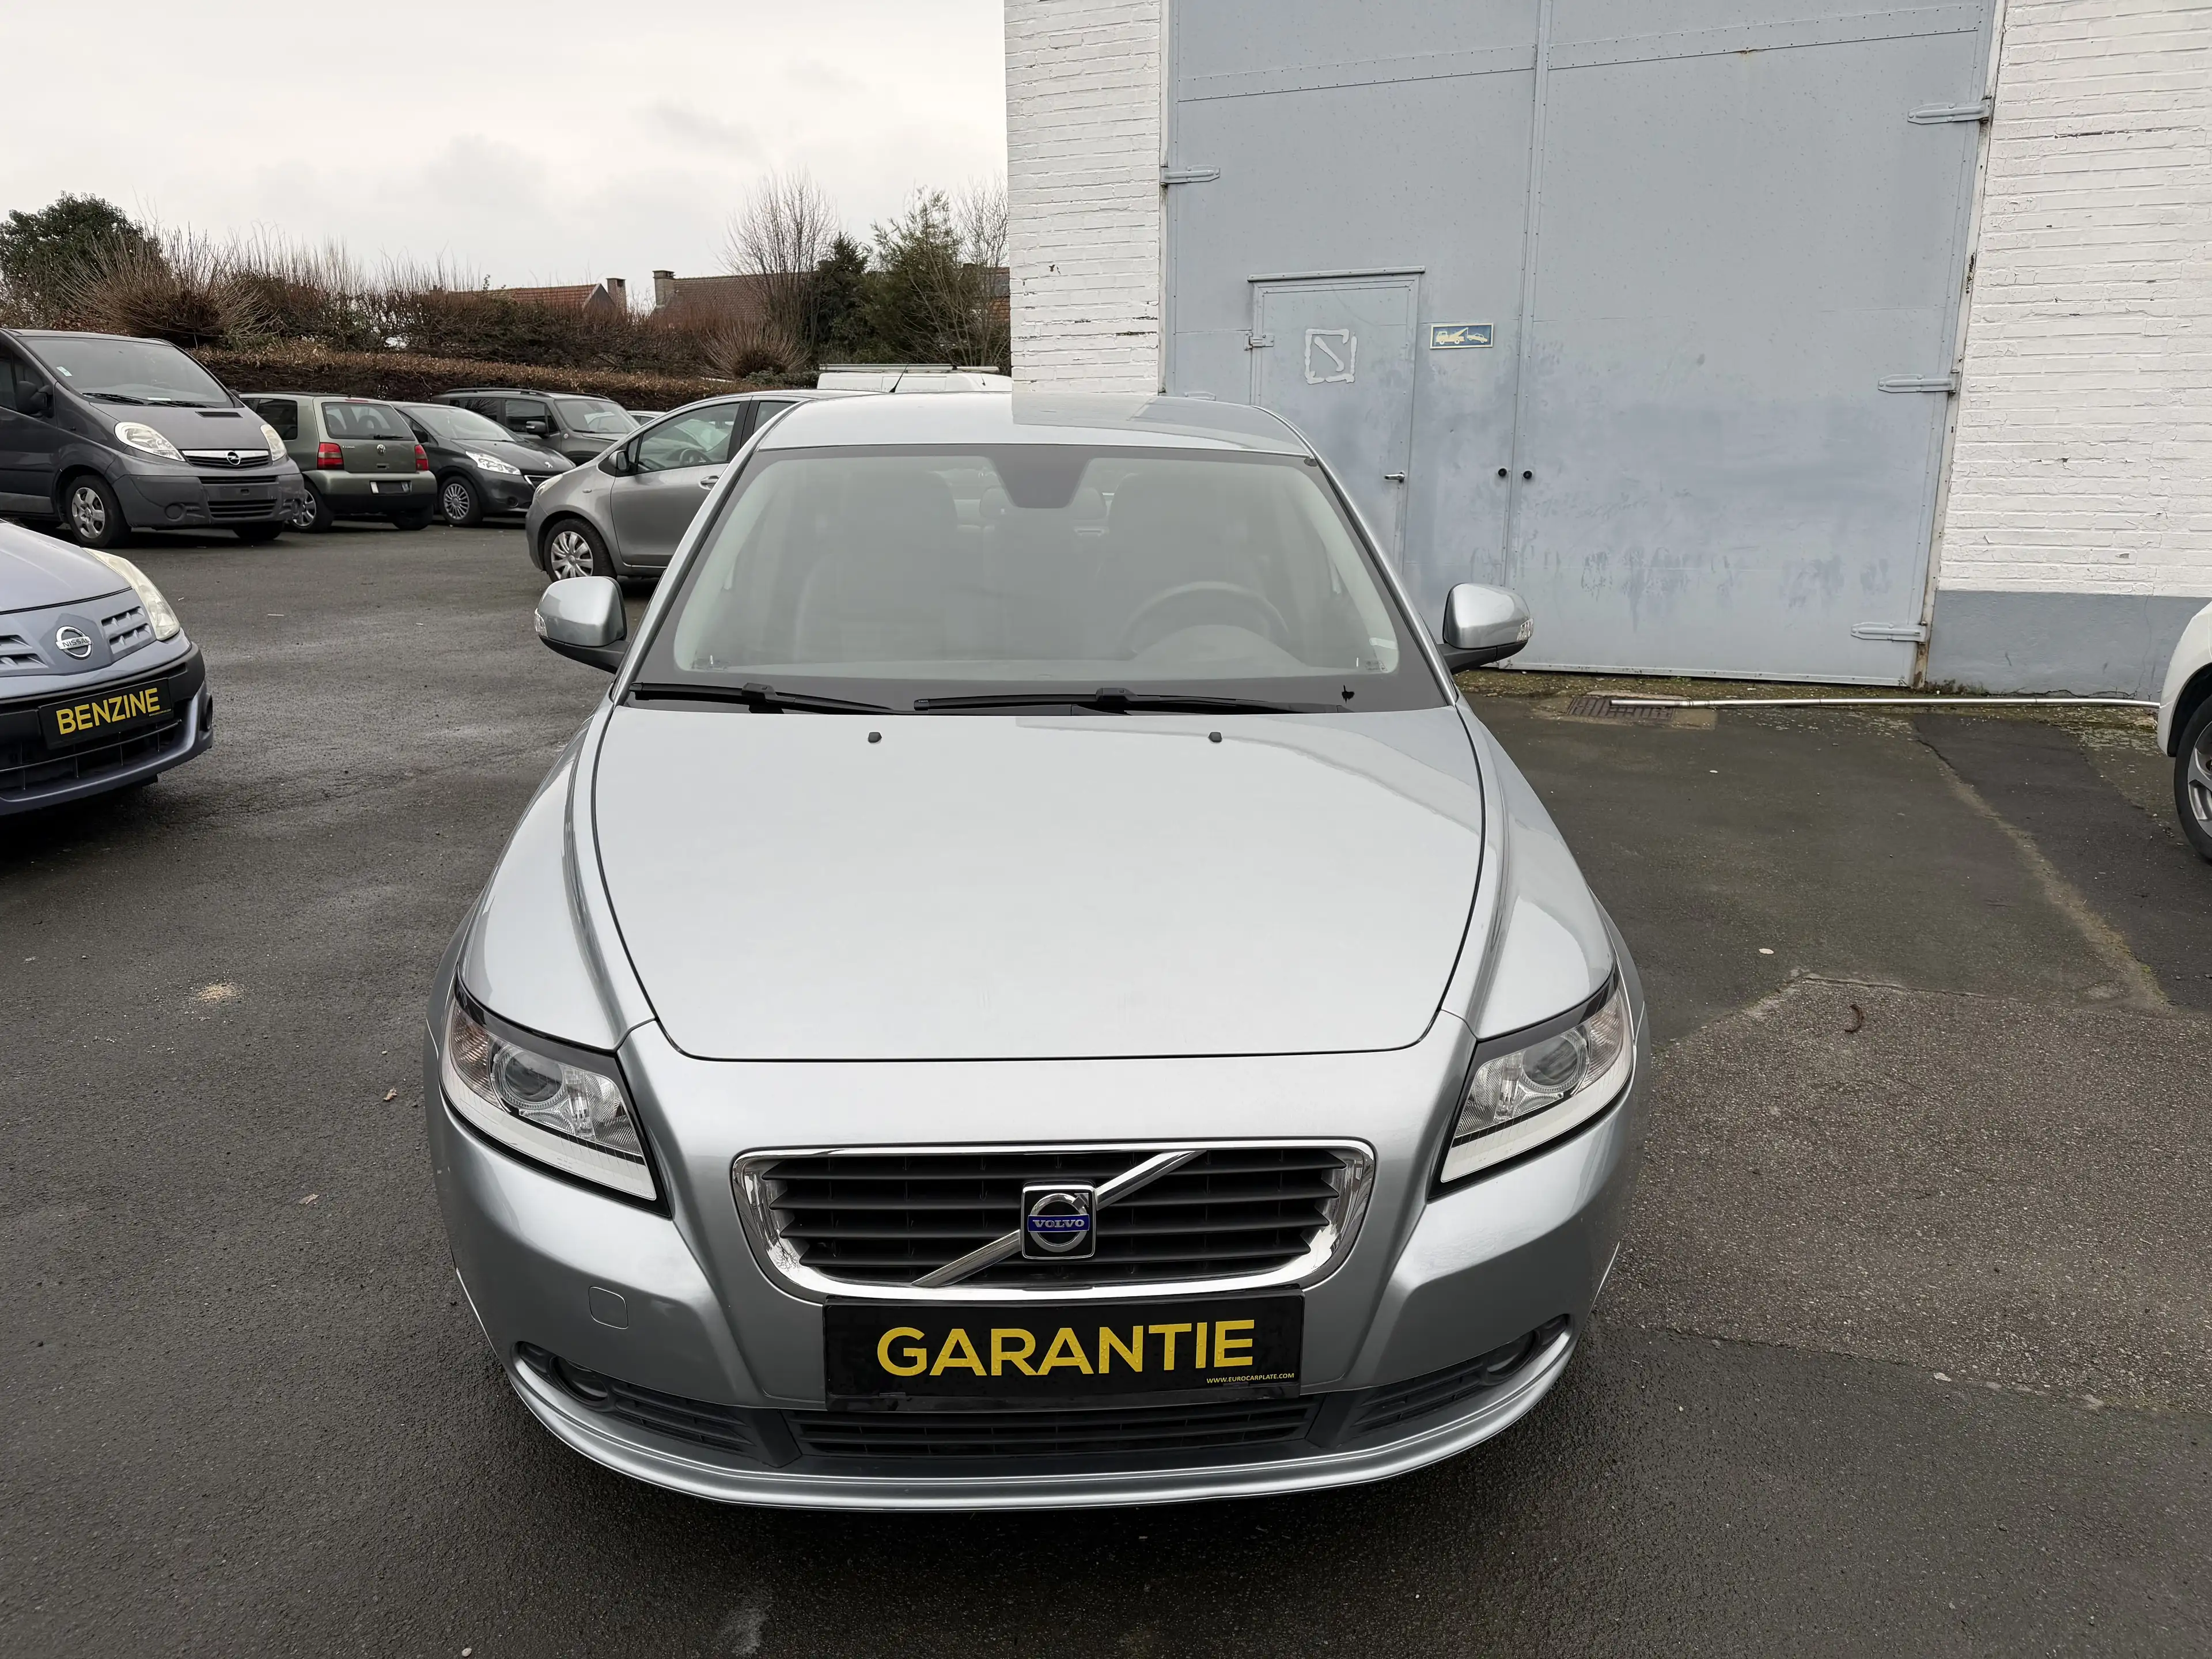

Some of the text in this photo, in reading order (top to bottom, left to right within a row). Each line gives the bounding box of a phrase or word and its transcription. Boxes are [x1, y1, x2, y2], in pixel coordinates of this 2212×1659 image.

[56, 687, 160, 734] BENZINE
[1032, 1219, 1085, 1228] VOLVO
[877, 1320, 1255, 1376] GARANTIE
[1206, 1373, 1294, 1383] WWW.EUROCARPLATE.COM
